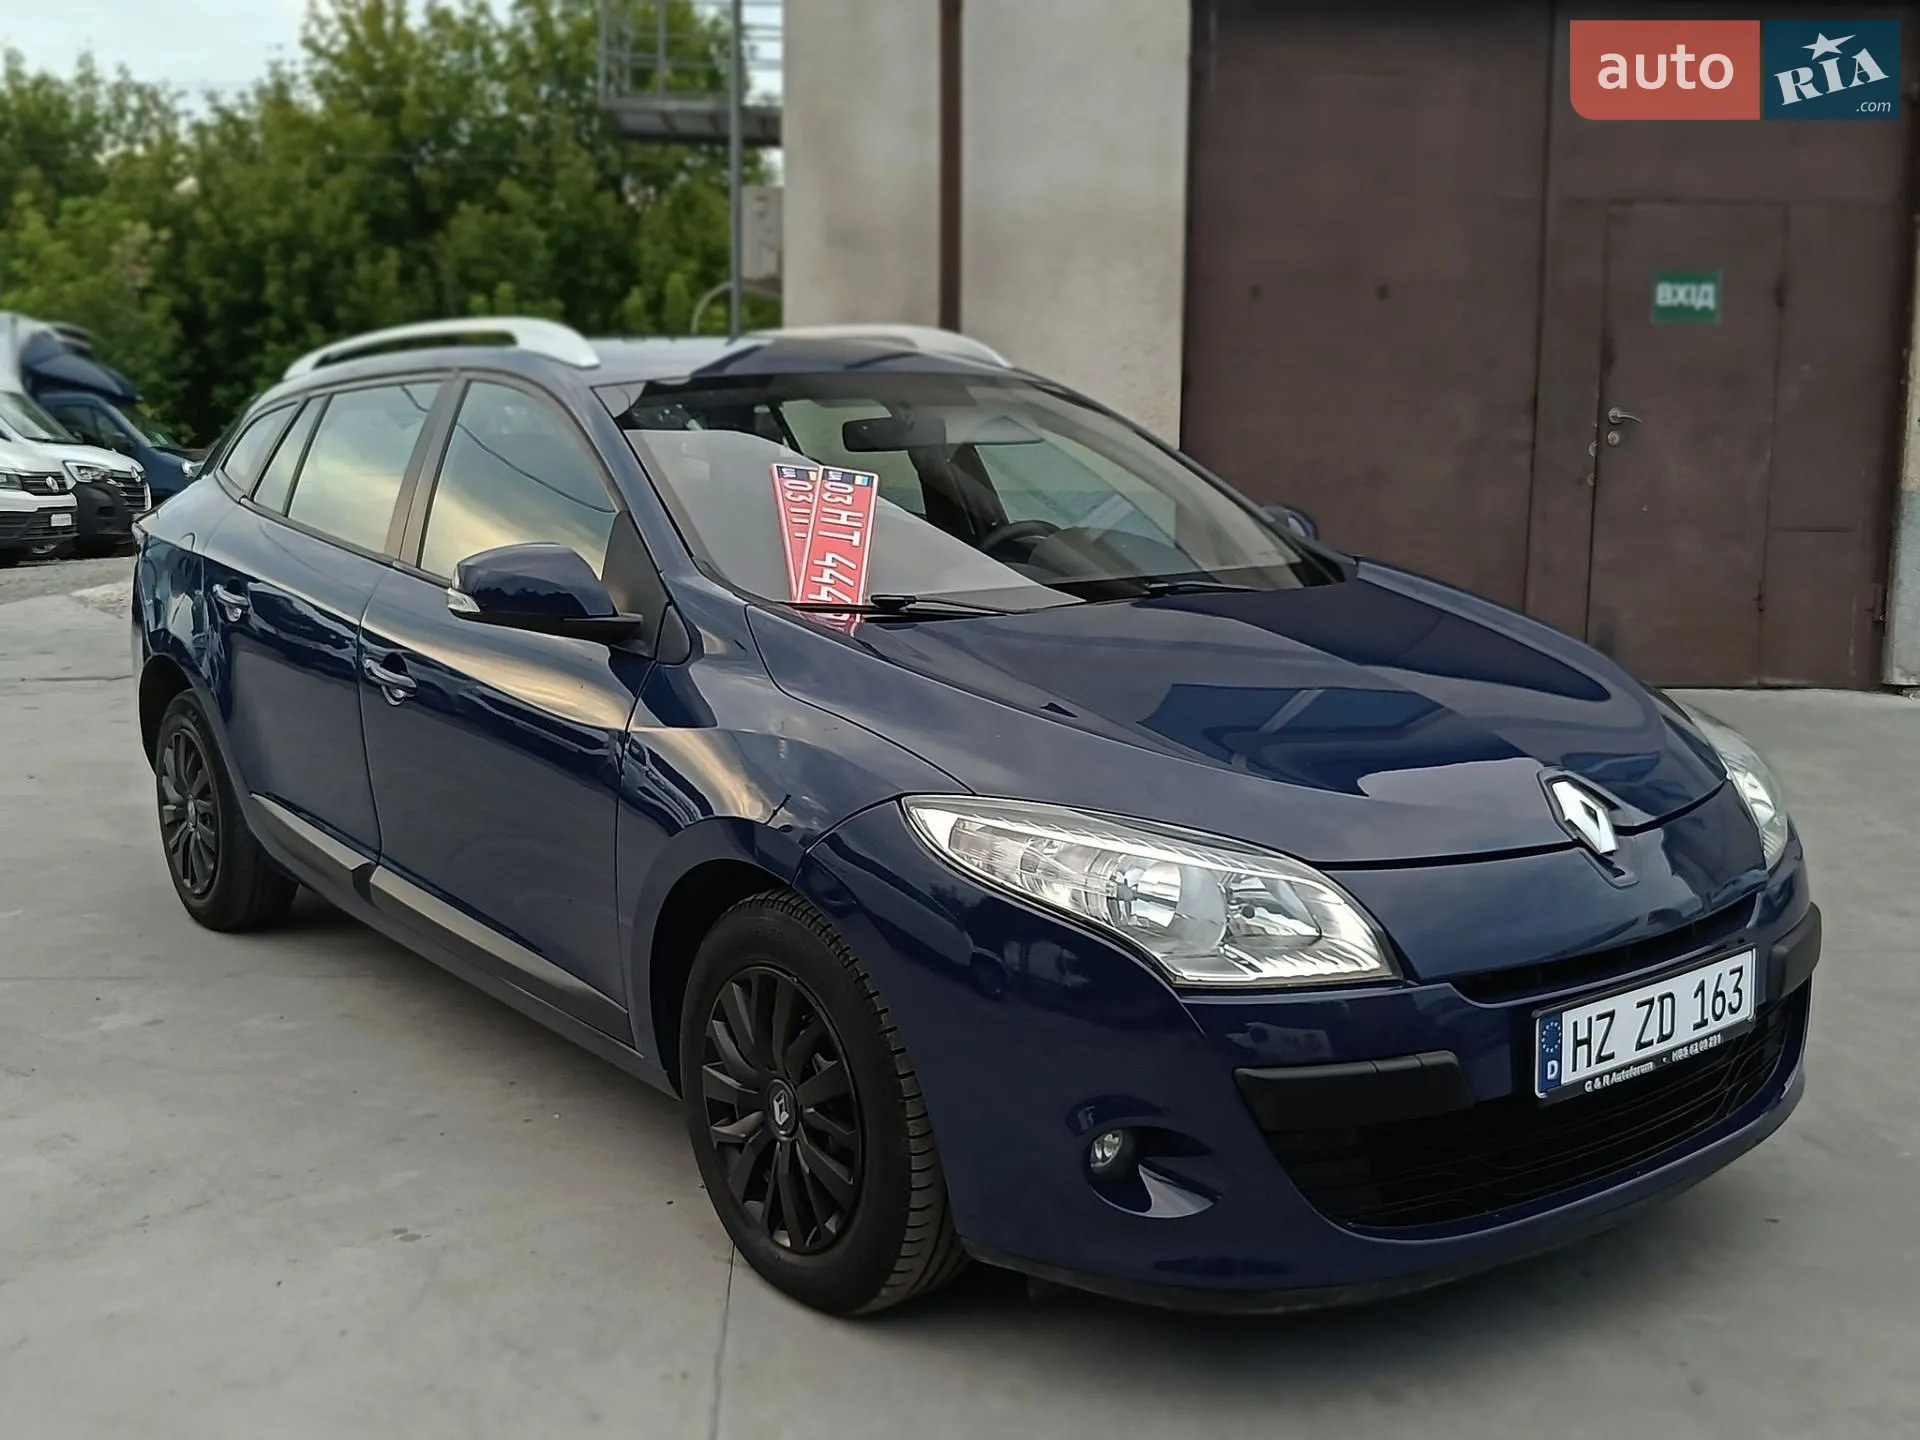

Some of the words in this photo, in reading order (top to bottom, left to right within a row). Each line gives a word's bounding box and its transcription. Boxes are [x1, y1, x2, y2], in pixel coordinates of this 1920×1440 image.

[1656, 281, 1715, 311] ВХІД
[1571, 1009, 1616, 1073] HZ
[1634, 991, 1676, 1052] ZD
[1691, 964, 1744, 1032] 163
[1546, 1060, 1559, 1081] D
